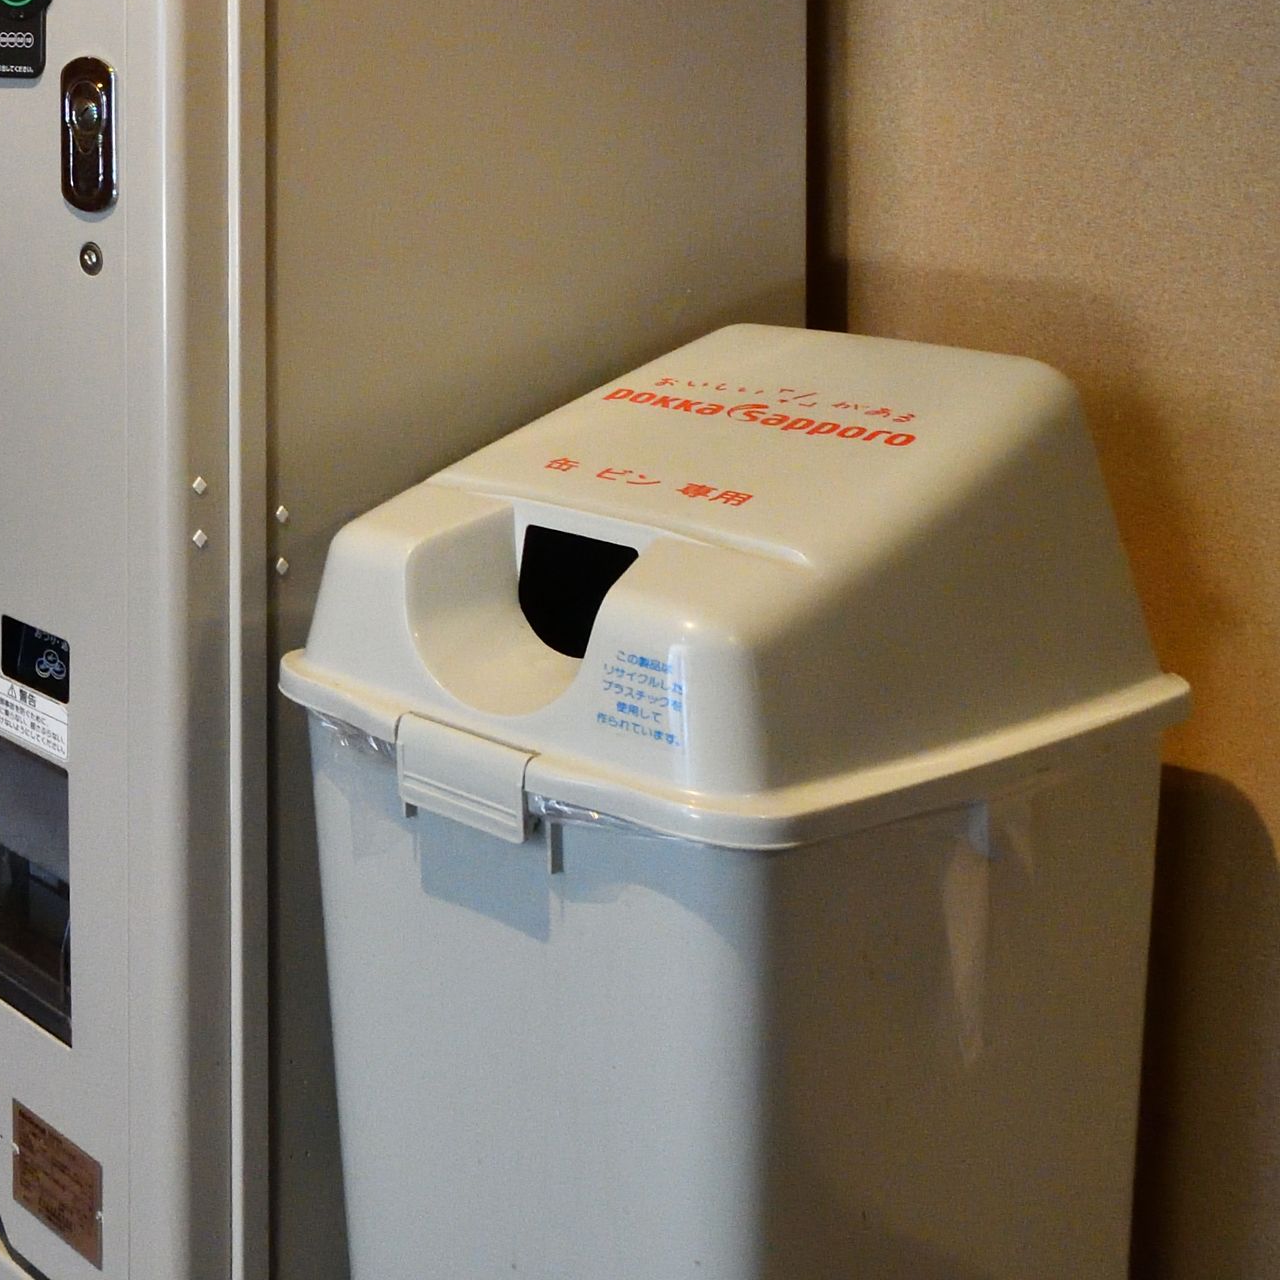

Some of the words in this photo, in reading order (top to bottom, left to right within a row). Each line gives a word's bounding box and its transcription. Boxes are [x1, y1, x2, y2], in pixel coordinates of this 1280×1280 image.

[544, 456, 581, 473] 缶
[595, 466, 662, 486] ビン
[675, 482, 755, 507] 専用
[19, 688, 37, 708] 警告
